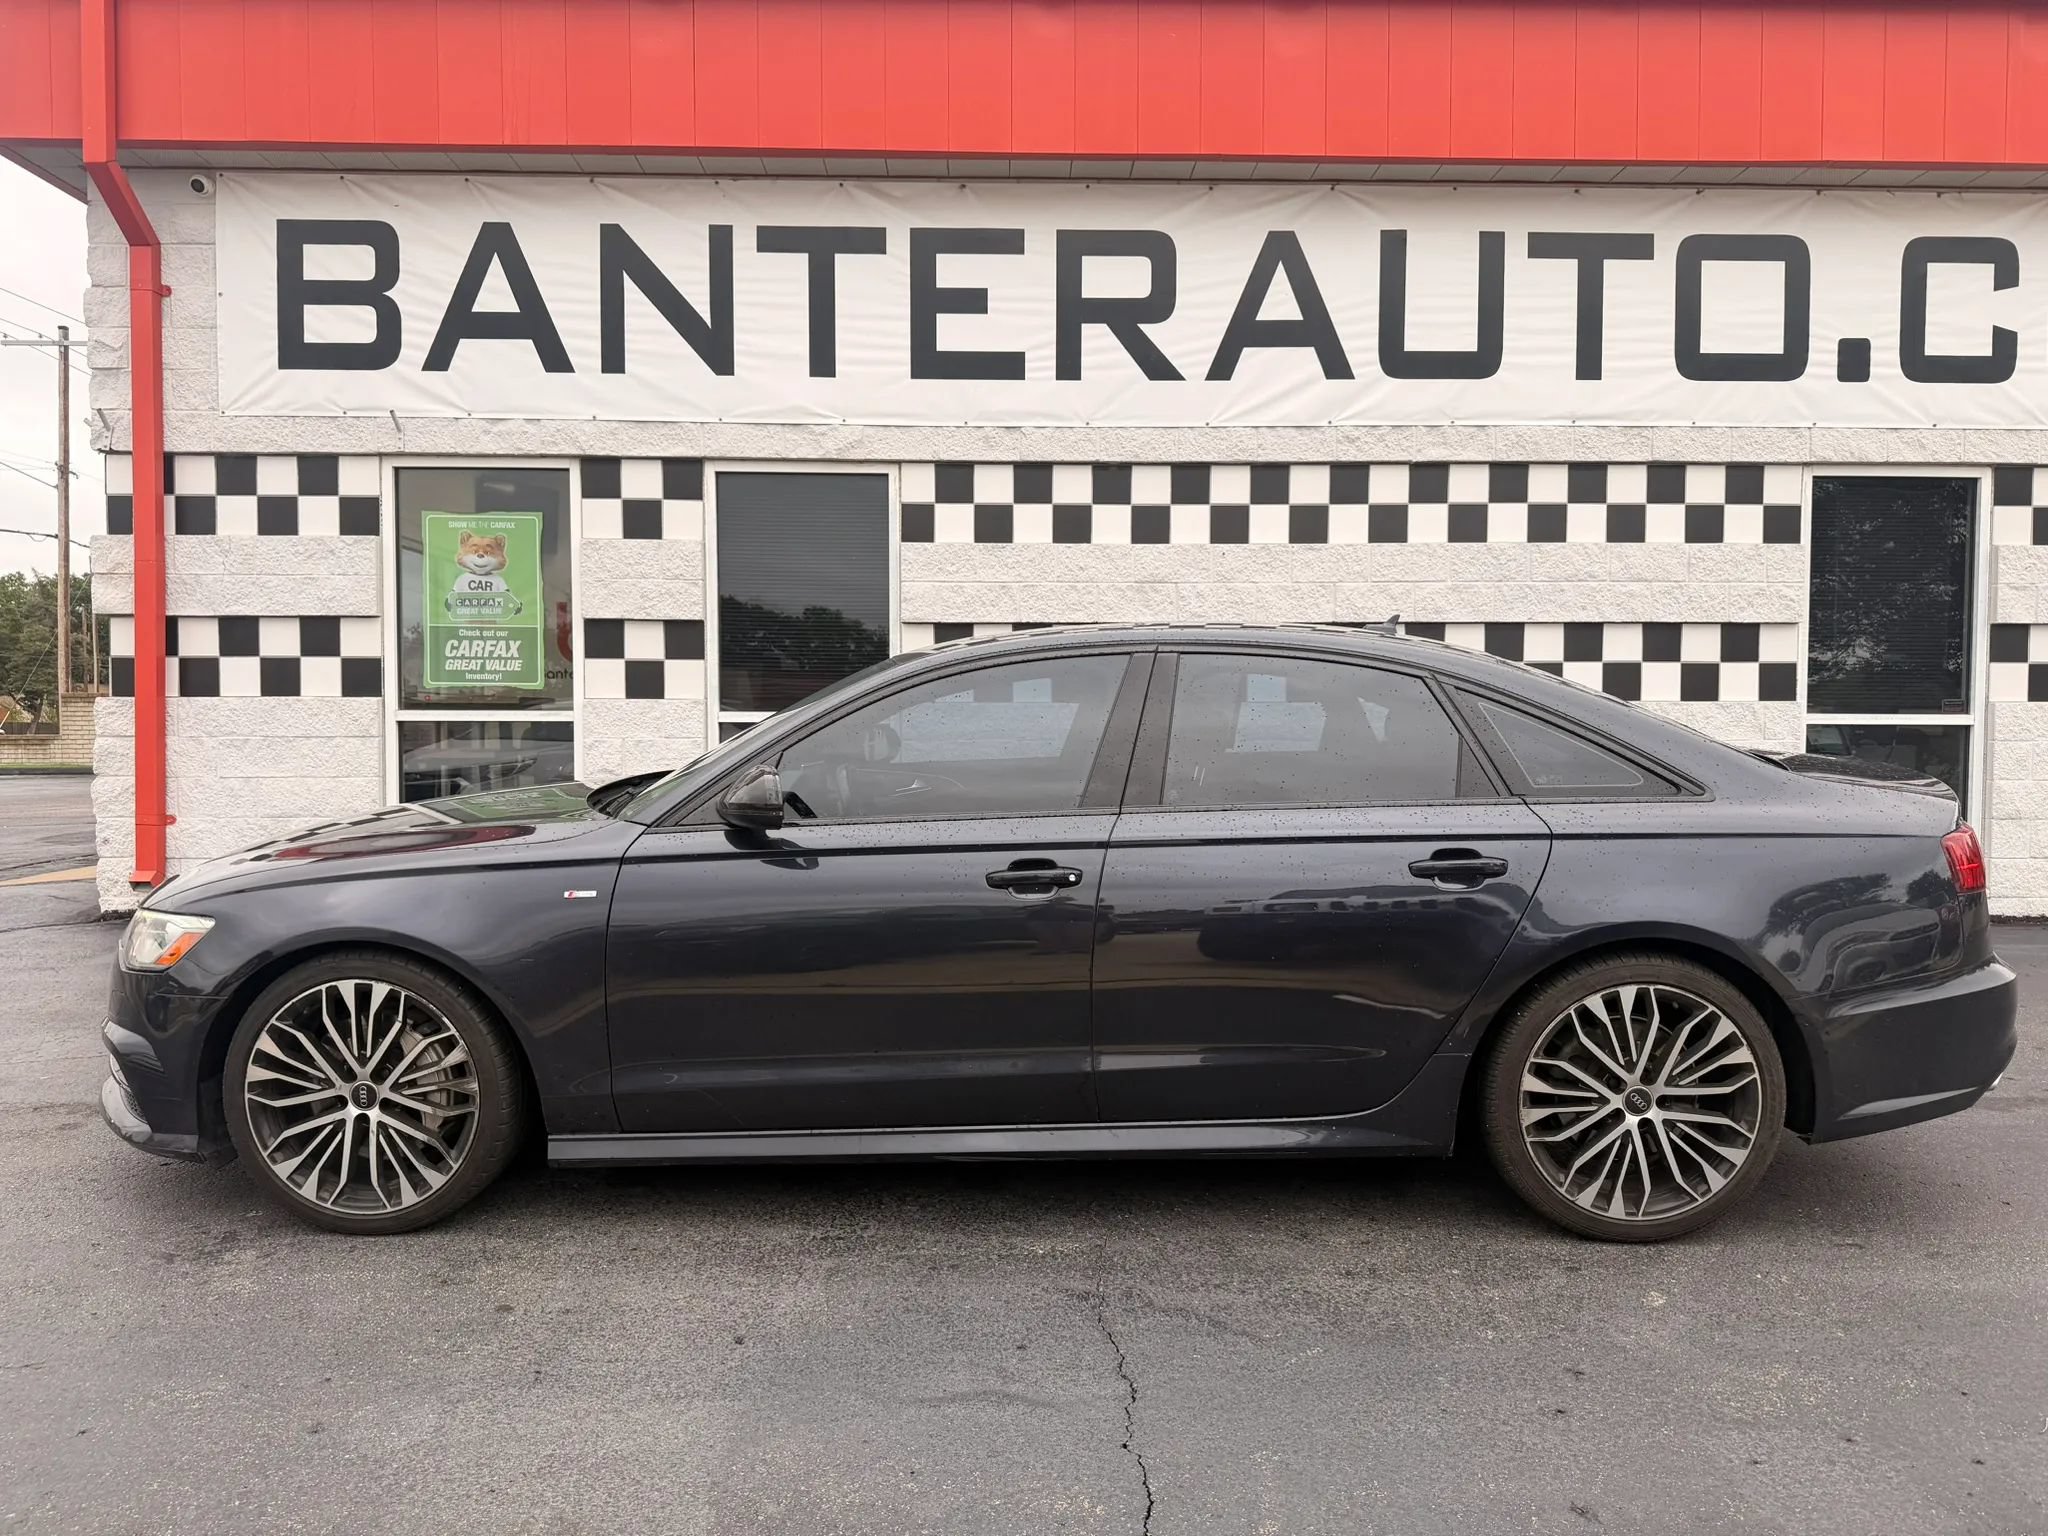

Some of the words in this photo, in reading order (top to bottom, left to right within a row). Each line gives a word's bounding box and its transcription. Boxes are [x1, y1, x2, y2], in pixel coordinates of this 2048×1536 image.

[276, 218, 2020, 384] BANTERAUTO.C
[491, 521, 516, 529] CARFAX
[467, 580, 493, 591] CAR
[455, 598, 504, 607] CARFAX
[456, 607, 479, 615] GREAT
[481, 607, 503, 615] VALUE
[458, 629, 481, 638] Check
[483, 630, 495, 638] out
[496, 630, 509, 638] our
[445, 639, 522, 658] CARFAX
[445, 659, 483, 671] GREAT
[485, 659, 523, 671] VALUE
[465, 672, 503, 682] Inventory!
